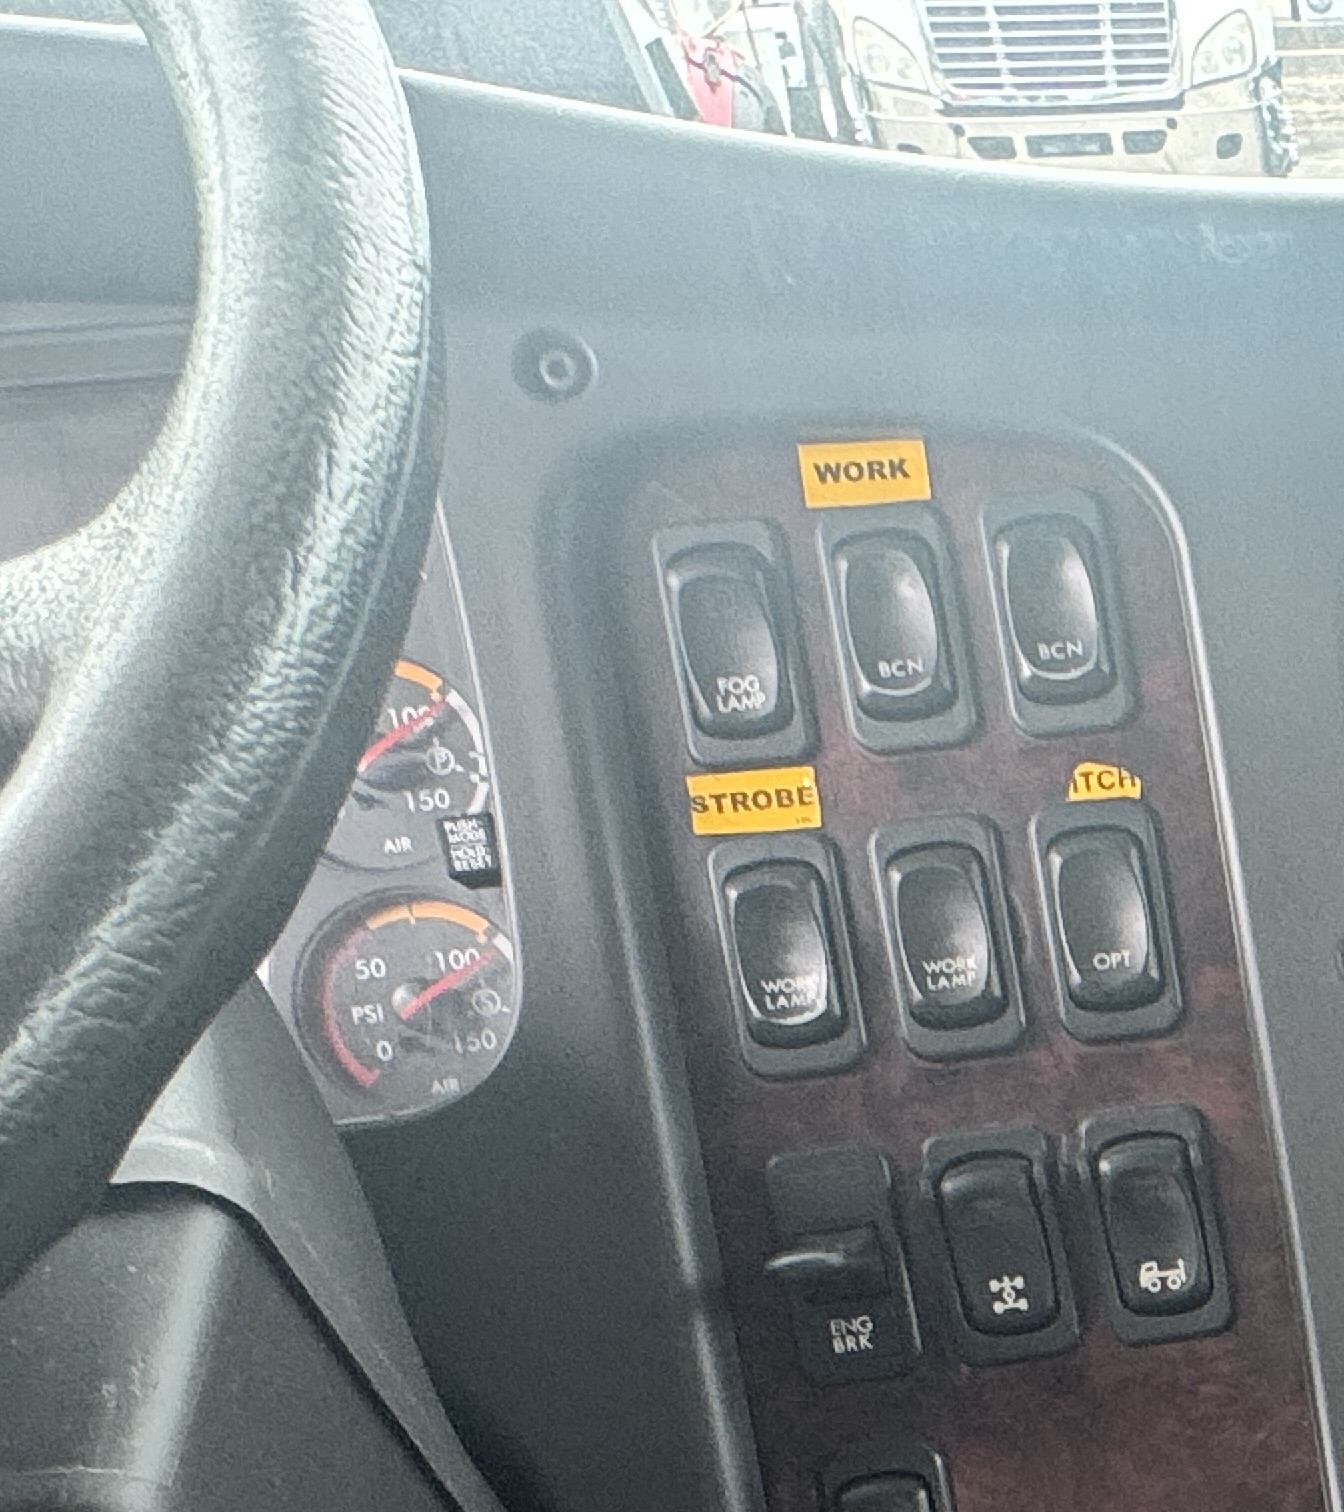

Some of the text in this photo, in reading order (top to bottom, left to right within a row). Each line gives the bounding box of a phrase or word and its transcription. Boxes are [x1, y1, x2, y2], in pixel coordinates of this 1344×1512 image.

[813, 458, 911, 484] WORK
[1037, 641, 1083, 660] BCN
[878, 658, 924, 678] BCN
[716, 675, 761, 695] FOG
[717, 691, 766, 712] LAMP
[402, 788, 450, 813] 150
[692, 785, 813, 815] STROBE
[383, 837, 413, 854] AIR
[355, 959, 386, 980] 50
[922, 955, 976, 976] WORK
[1093, 951, 1130, 972] OPT
[927, 971, 976, 991] LAMP
[351, 1003, 384, 1025] PSI
[376, 1040, 392, 1062] 0
[454, 1029, 497, 1054] 150
[829, 1316, 874, 1337] ENG
[833, 1333, 874, 1353] BRK
